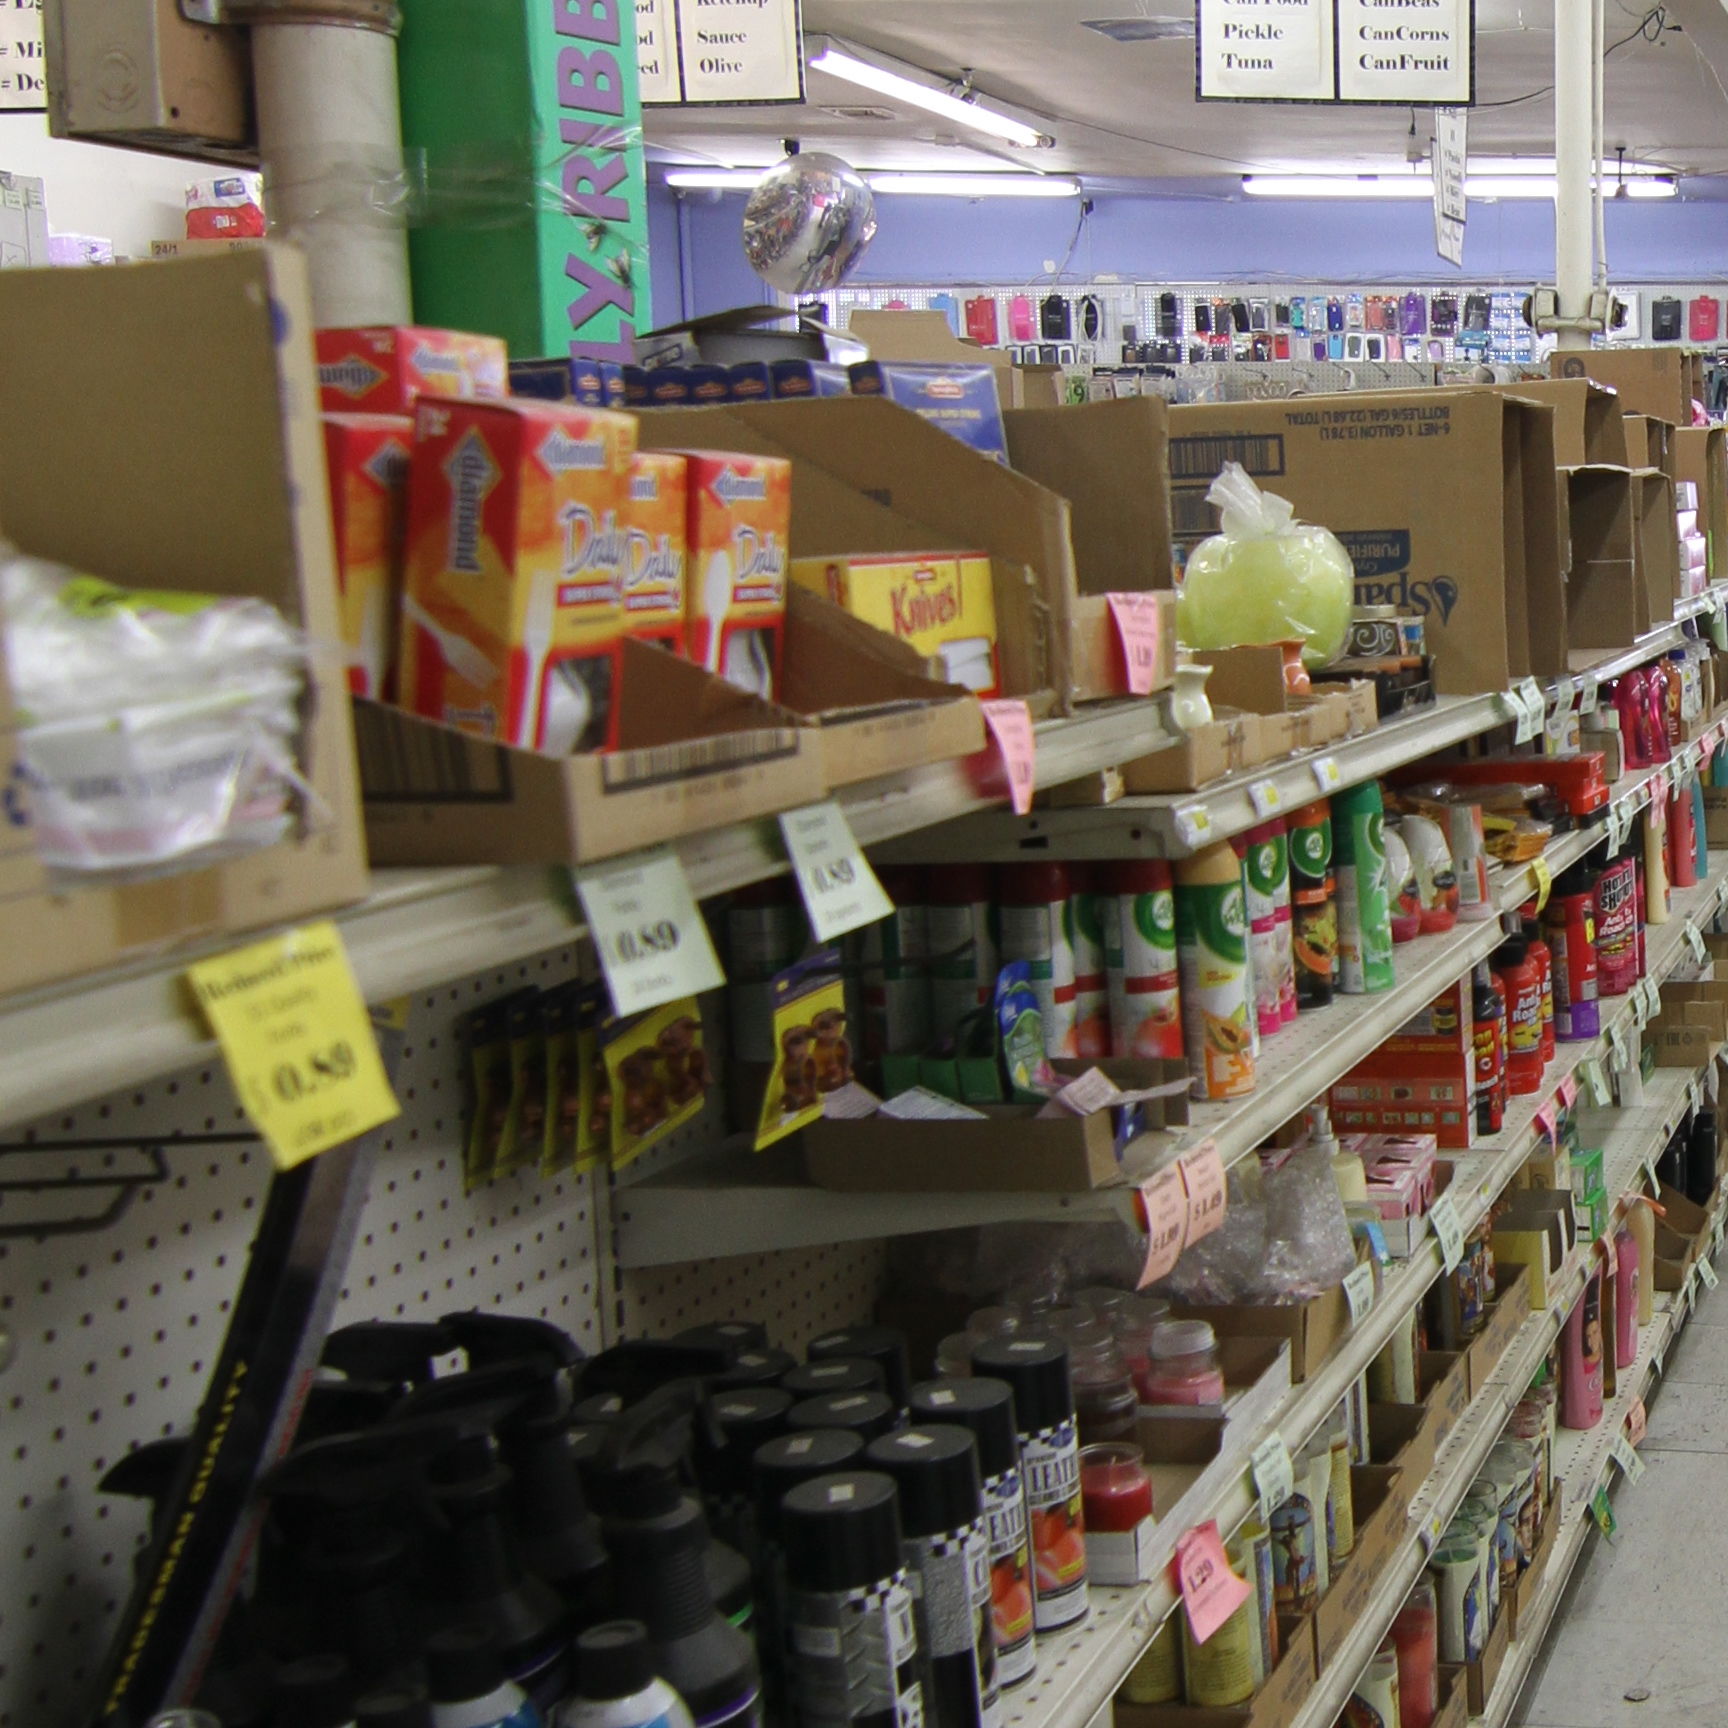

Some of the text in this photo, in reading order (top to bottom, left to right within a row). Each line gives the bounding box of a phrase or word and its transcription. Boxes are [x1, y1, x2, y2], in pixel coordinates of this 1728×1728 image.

[697, 29, 747, 44] Sauce
[1222, 23, 1284, 40] Pickle
[1359, 25, 1449, 41] CanCorns
[700, 58, 743, 73] Olive
[1221, 53, 1273, 70] Tuna
[1359, 54, 1450, 71] CanFruit
[1285, 411, 1320, 426] TOTAL
[1369, 407, 1389, 422] GAL
[1360, 424, 1405, 438] GALLON
[624, 526, 682, 590] Daily
[733, 525, 785, 587] Daily
[890, 584, 957, 636] Knives
[105, 1510, 195, 1716] TRADESMAN
[188, 1360, 248, 1504] QUALITY
[1187, 1560, 1214, 1594] 1.29
